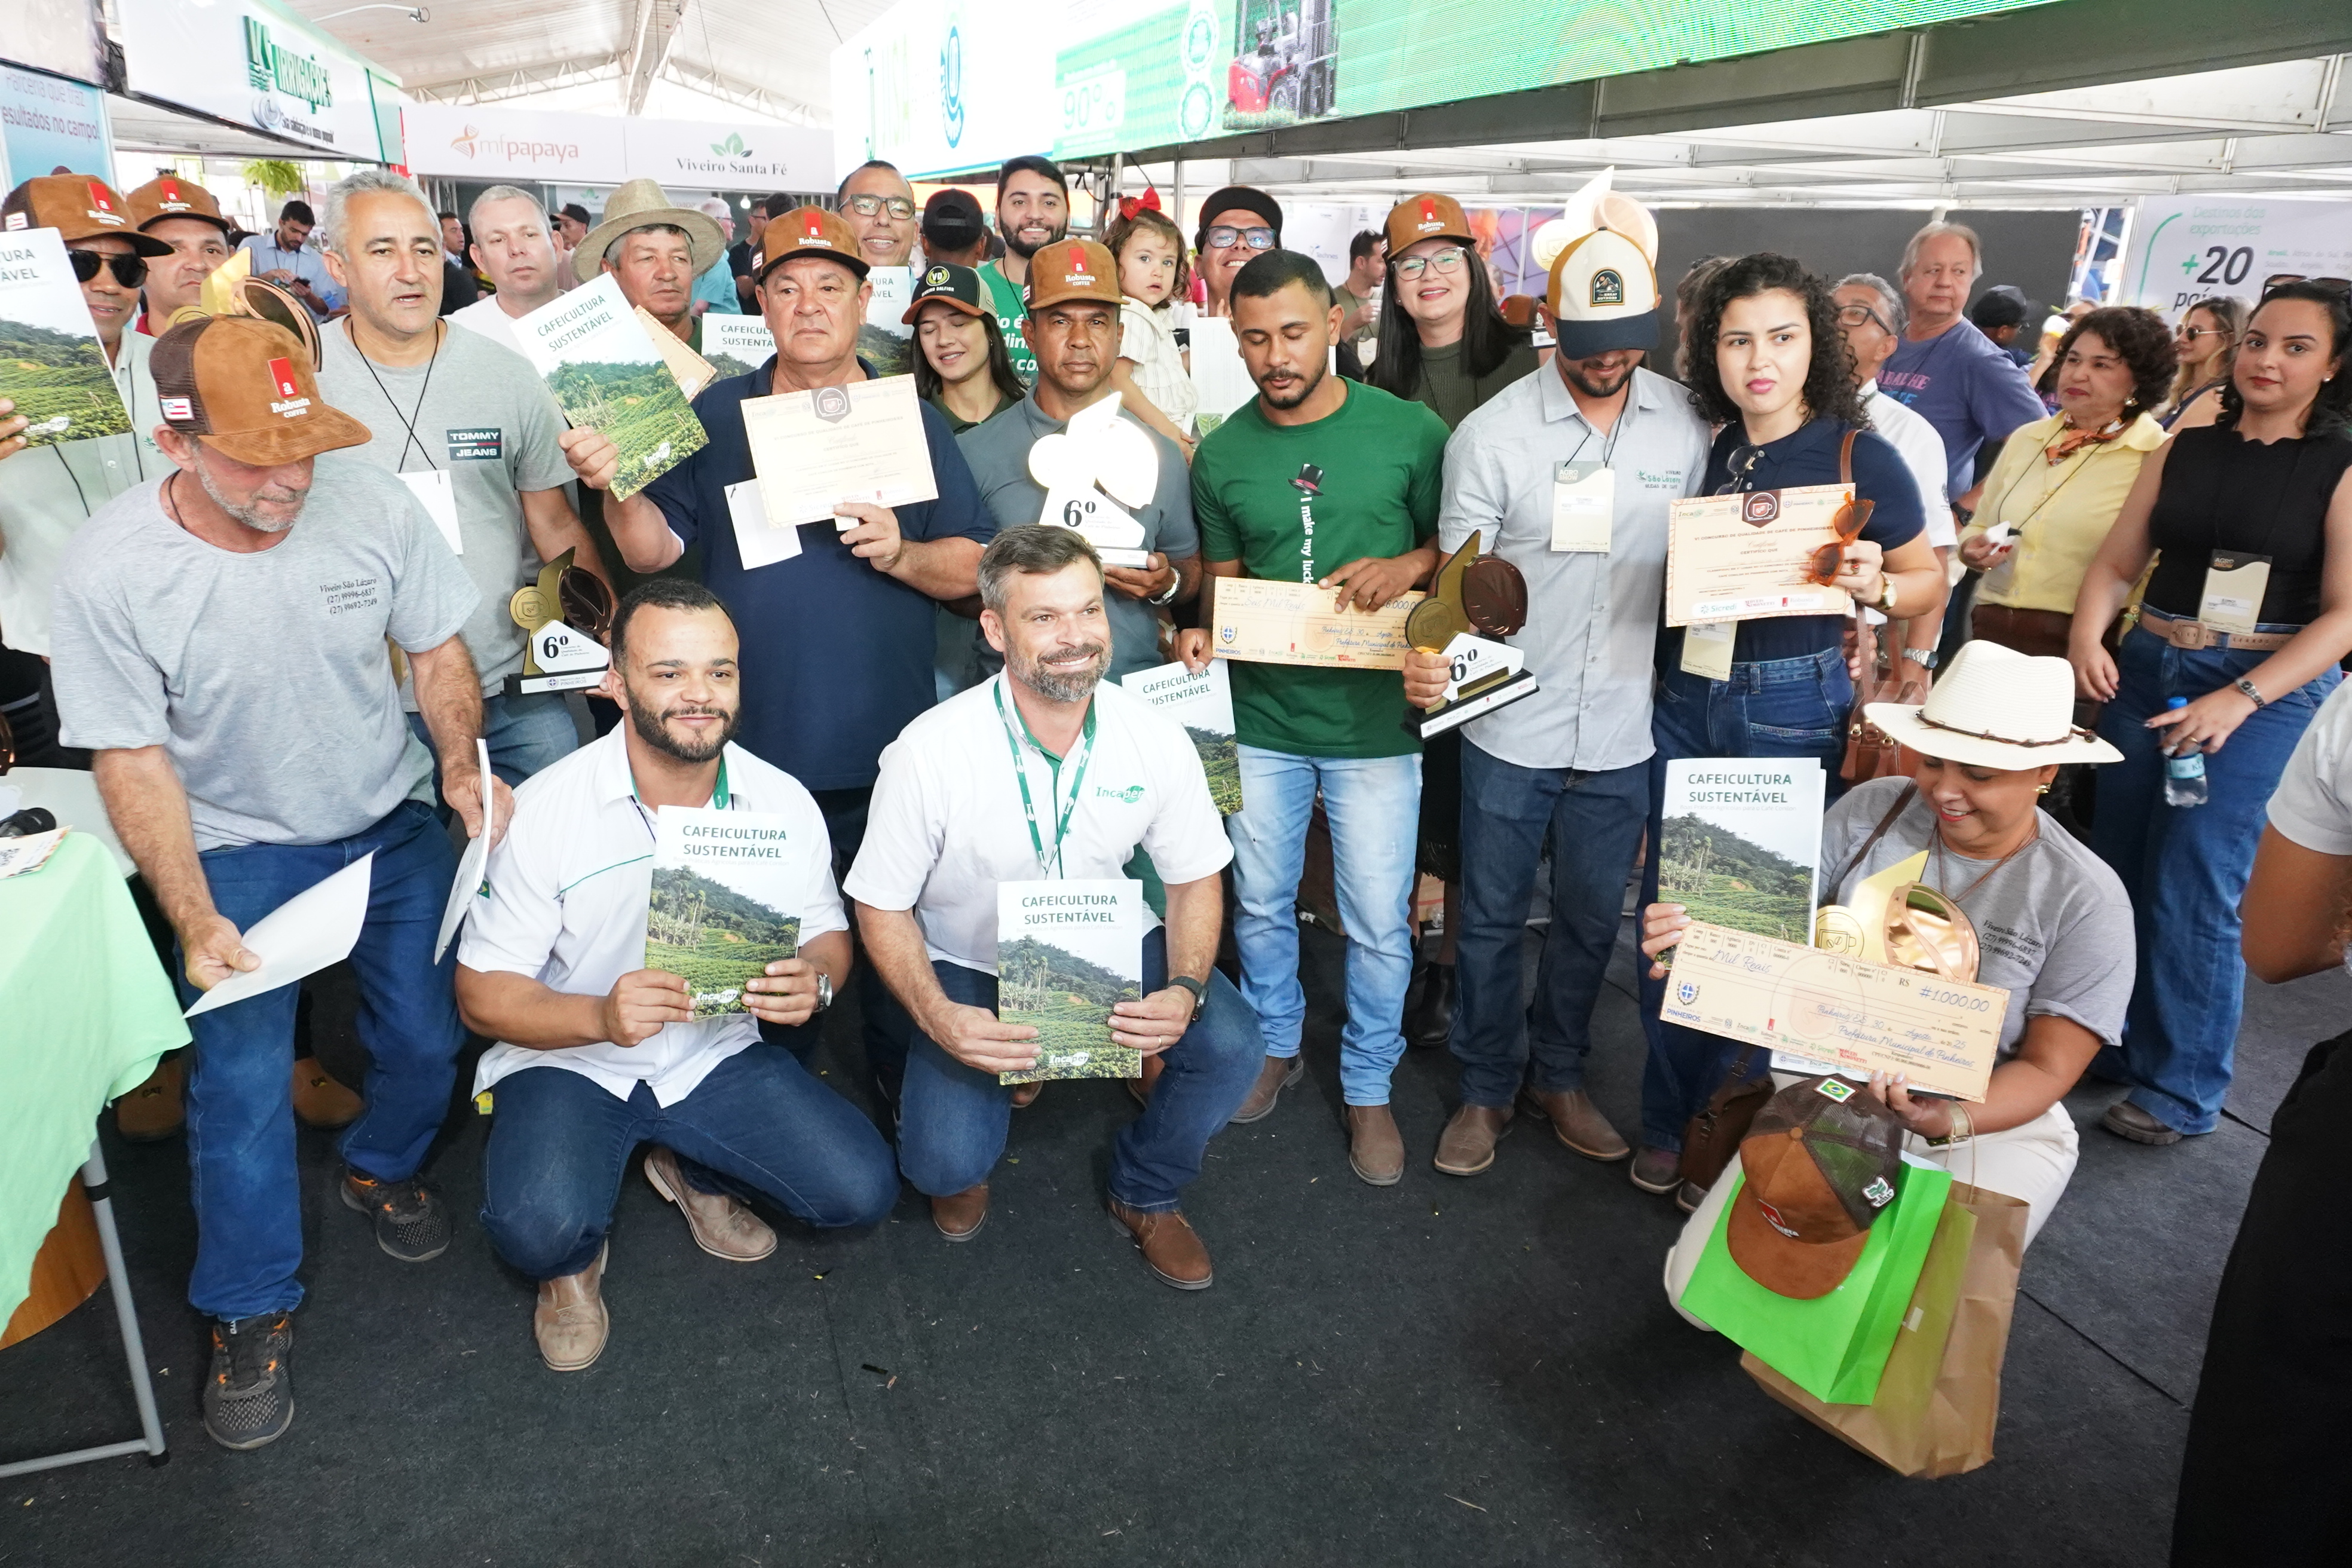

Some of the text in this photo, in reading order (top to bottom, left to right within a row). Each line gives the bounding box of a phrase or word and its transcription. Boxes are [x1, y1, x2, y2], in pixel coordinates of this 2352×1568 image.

[271, 44, 332, 114] IRRIGAÇÕES
[48, 82, 66, 105] que
[1064, 82, 1116, 131] 90%
[2, 104, 100, 143] esultados no campo!
[480, 134, 578, 163] mfpapaya
[676, 157, 788, 176] Viveiro Santa Fé
[2193, 206, 2266, 218] Destinos das
[1418, 221, 1445, 231] Robusta
[2189, 223, 2261, 237] exportações
[798, 237, 832, 247] Robusta
[932, 272, 942, 281] VD
[1065, 274, 1095, 283] Robusta
[537, 295, 606, 337] CAFEICULTURA
[549, 311, 614, 352] SUSTENTÁVEL
[270, 397, 311, 414] Robusta
[283, 408, 307, 418] COFFEE
[450, 431, 500, 440] TOMMY
[456, 448, 497, 457] JEANS
[1662, 475, 1681, 483] Lázaro
[1301, 505, 1315, 536] make
[1301, 539, 1314, 557] my
[320, 583, 341, 593] Viveiro
[356, 578, 376, 587] Lázaro
[327, 595, 341, 604] (27)
[330, 598, 378, 615] (27) 99692-7249
[1244, 596, 1305, 611] Seis Mil Reais
[1711, 604, 1737, 612] Sicredi
[1143, 669, 1211, 694] CAFEICULTURA
[1688, 774, 1792, 785] CAFEICULTURA
[1096, 786, 1145, 803] Incaper
[1689, 789, 1788, 803] SUSTENTÁVEL
[682, 825, 787, 841] CAFEICULTURA
[683, 844, 782, 859] SUSTENTÁVEL
[1022, 895, 1118, 908] CAFEICULTURA
[1024, 909, 1115, 924] SUSTENTÁVEL
[1983, 932, 1997, 942] (27)
[2019, 933, 2044, 948] Lázaro
[1713, 949, 1772, 973] Mil Reais
[1855, 963, 1871, 973] Cheque
[696, 990, 739, 1004] Incaper
[1919, 987, 1990, 1012] #1.000,00
[1666, 1008, 1701, 1022] PINHEIROS
[1872, 1020, 1885, 1028] 30
[1905, 1028, 1932, 1042] Agosto
[1953, 1040, 1967, 1050] 25
[1838, 1025, 1975, 1067] Prefeitura Municipal de Pinheiros
[1049, 1053, 1089, 1065] Incaper
